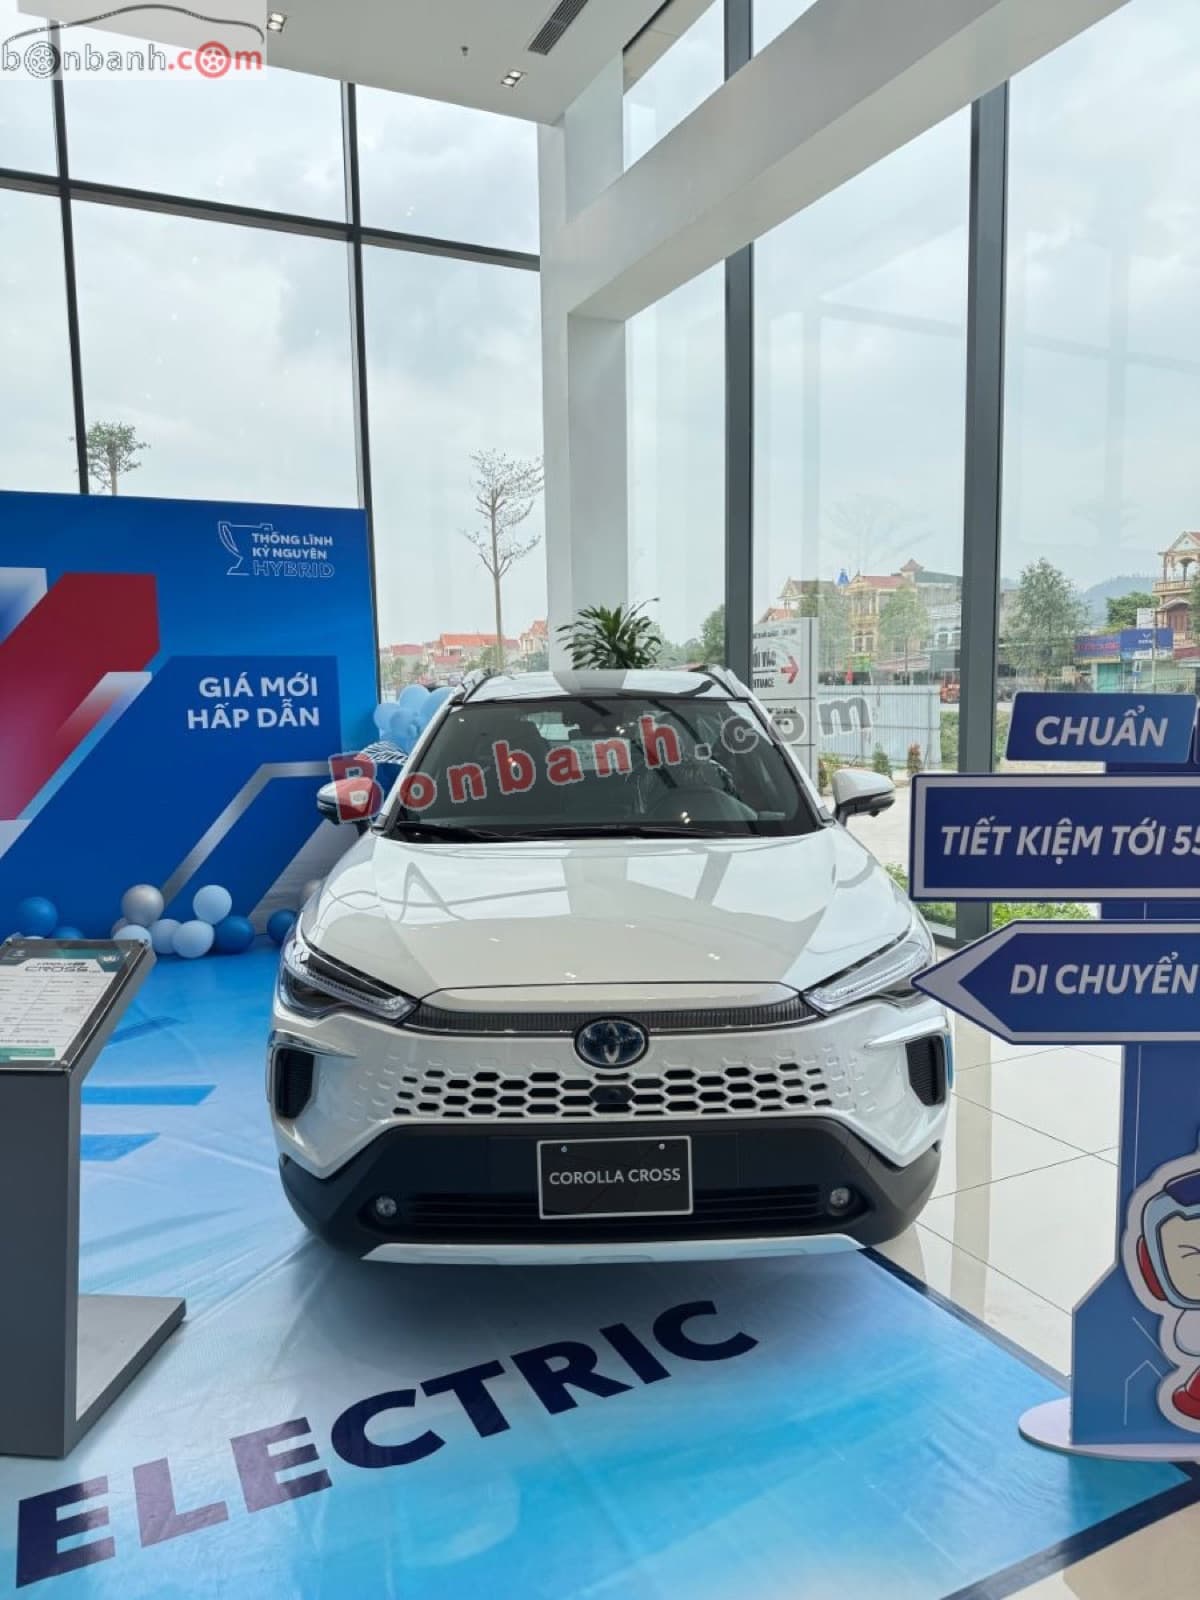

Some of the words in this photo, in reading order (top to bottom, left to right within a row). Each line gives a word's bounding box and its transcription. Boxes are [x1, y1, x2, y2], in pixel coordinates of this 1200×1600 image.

[253, 559, 336, 578] HYBRID
[273, 547, 327, 560] NGUYÊN
[199, 671, 254, 698] GIÁ
[260, 671, 319, 697] MỚI
[187, 702, 250, 730] HẤP
[257, 698, 320, 729] DẪN
[1035, 705, 1169, 747] CHUẨN
[941, 815, 1012, 856] TIẾT
[1016, 817, 1103, 865] KIỆM
[1111, 817, 1165, 856] TỚI
[1010, 964, 1048, 995] DI
[1055, 951, 1199, 995] CHUYỂN
[549, 1170, 625, 1185] COROLLA
[628, 1167, 681, 1183] CROSS
[16, 1300, 759, 1588] ELECTRIC
